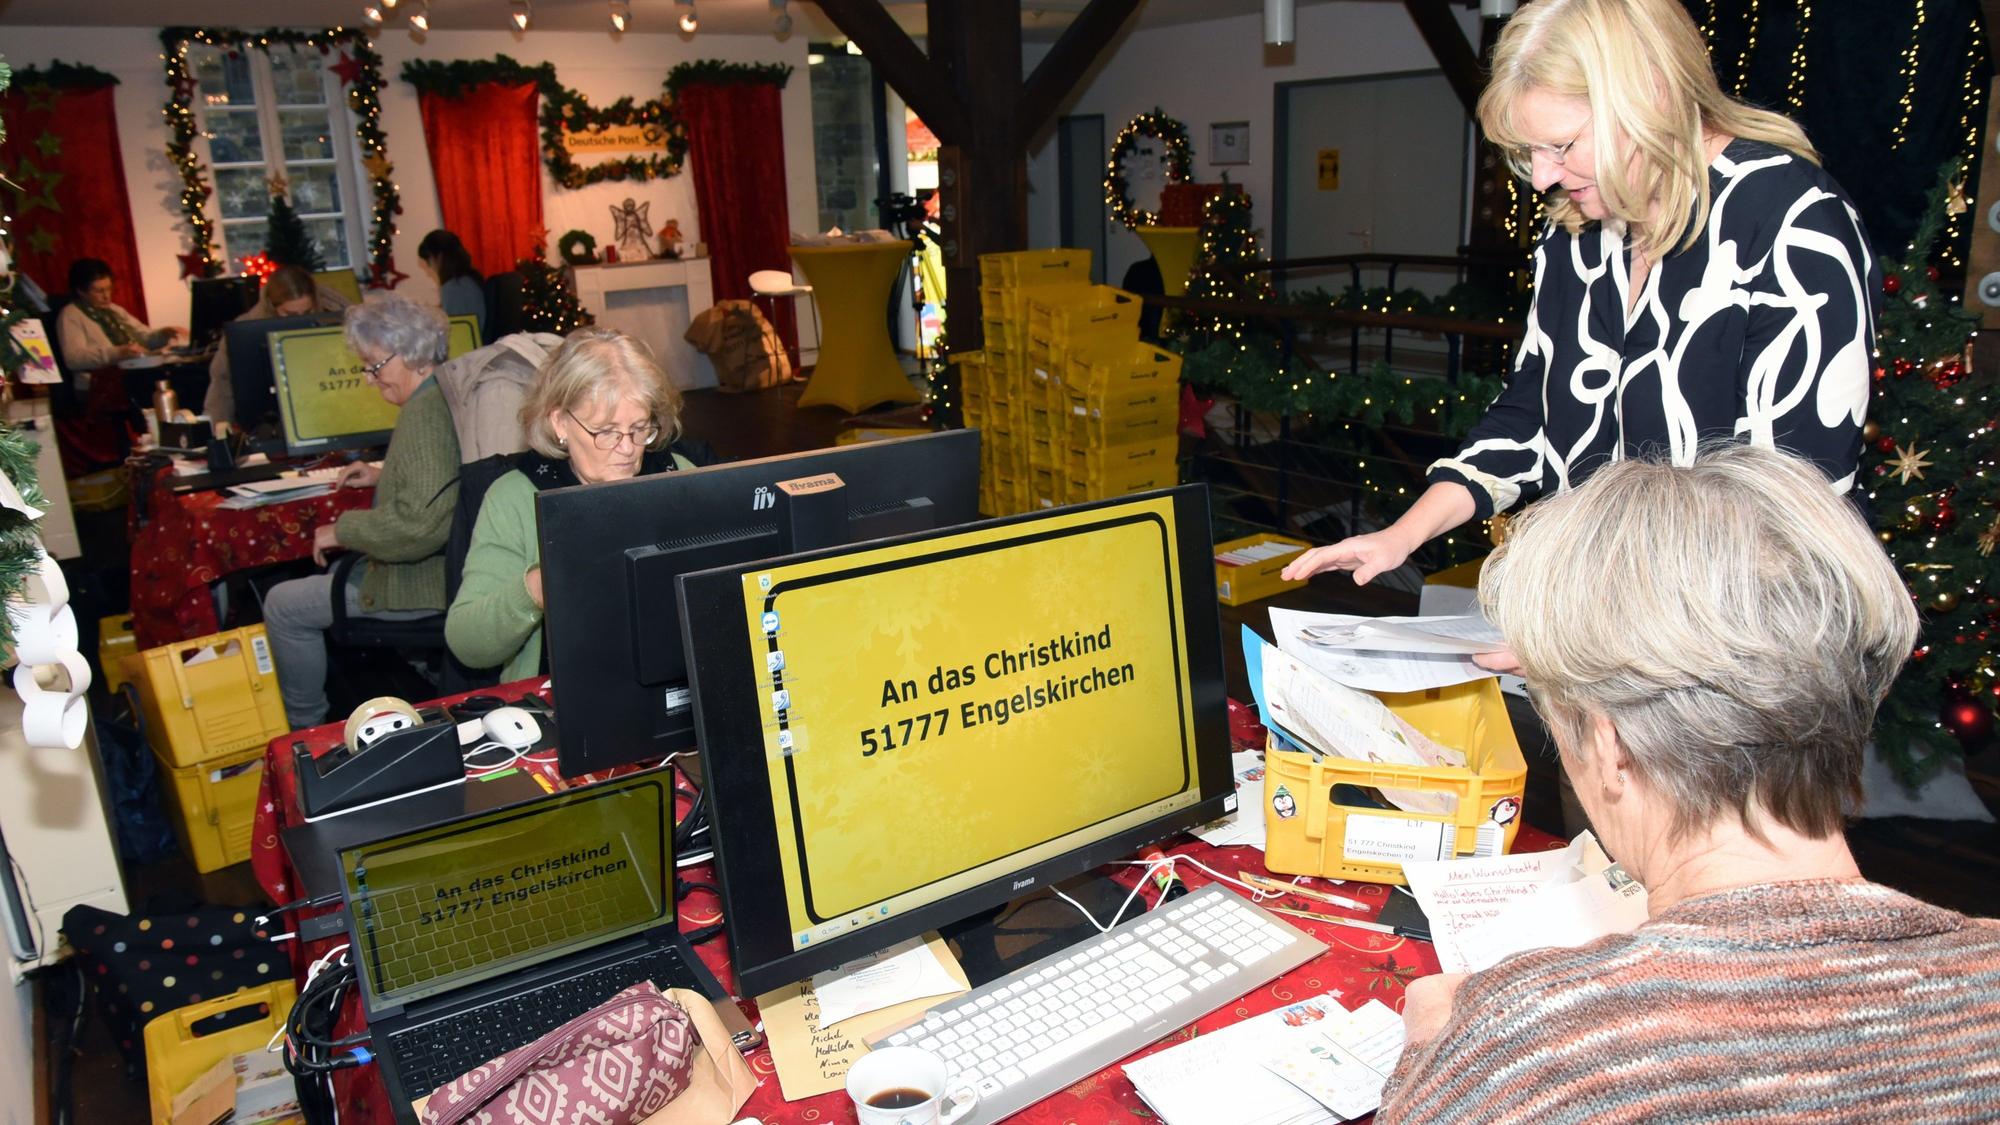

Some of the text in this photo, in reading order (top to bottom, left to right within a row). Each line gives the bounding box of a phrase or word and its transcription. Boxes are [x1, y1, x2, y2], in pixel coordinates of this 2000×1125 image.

[569, 135, 640, 146] Deutsche Post
[328, 367, 346, 376] An
[319, 378, 360, 391] 51777
[753, 486, 776, 511] iiy
[881, 624, 1112, 707] An das Christkind
[860, 663, 1135, 757] 51777 Engelskirchen
[1377, 840, 1416, 851] Christkind
[435, 842, 611, 902] An das Christkind
[420, 859, 628, 926] 51777 Engelskirchen
